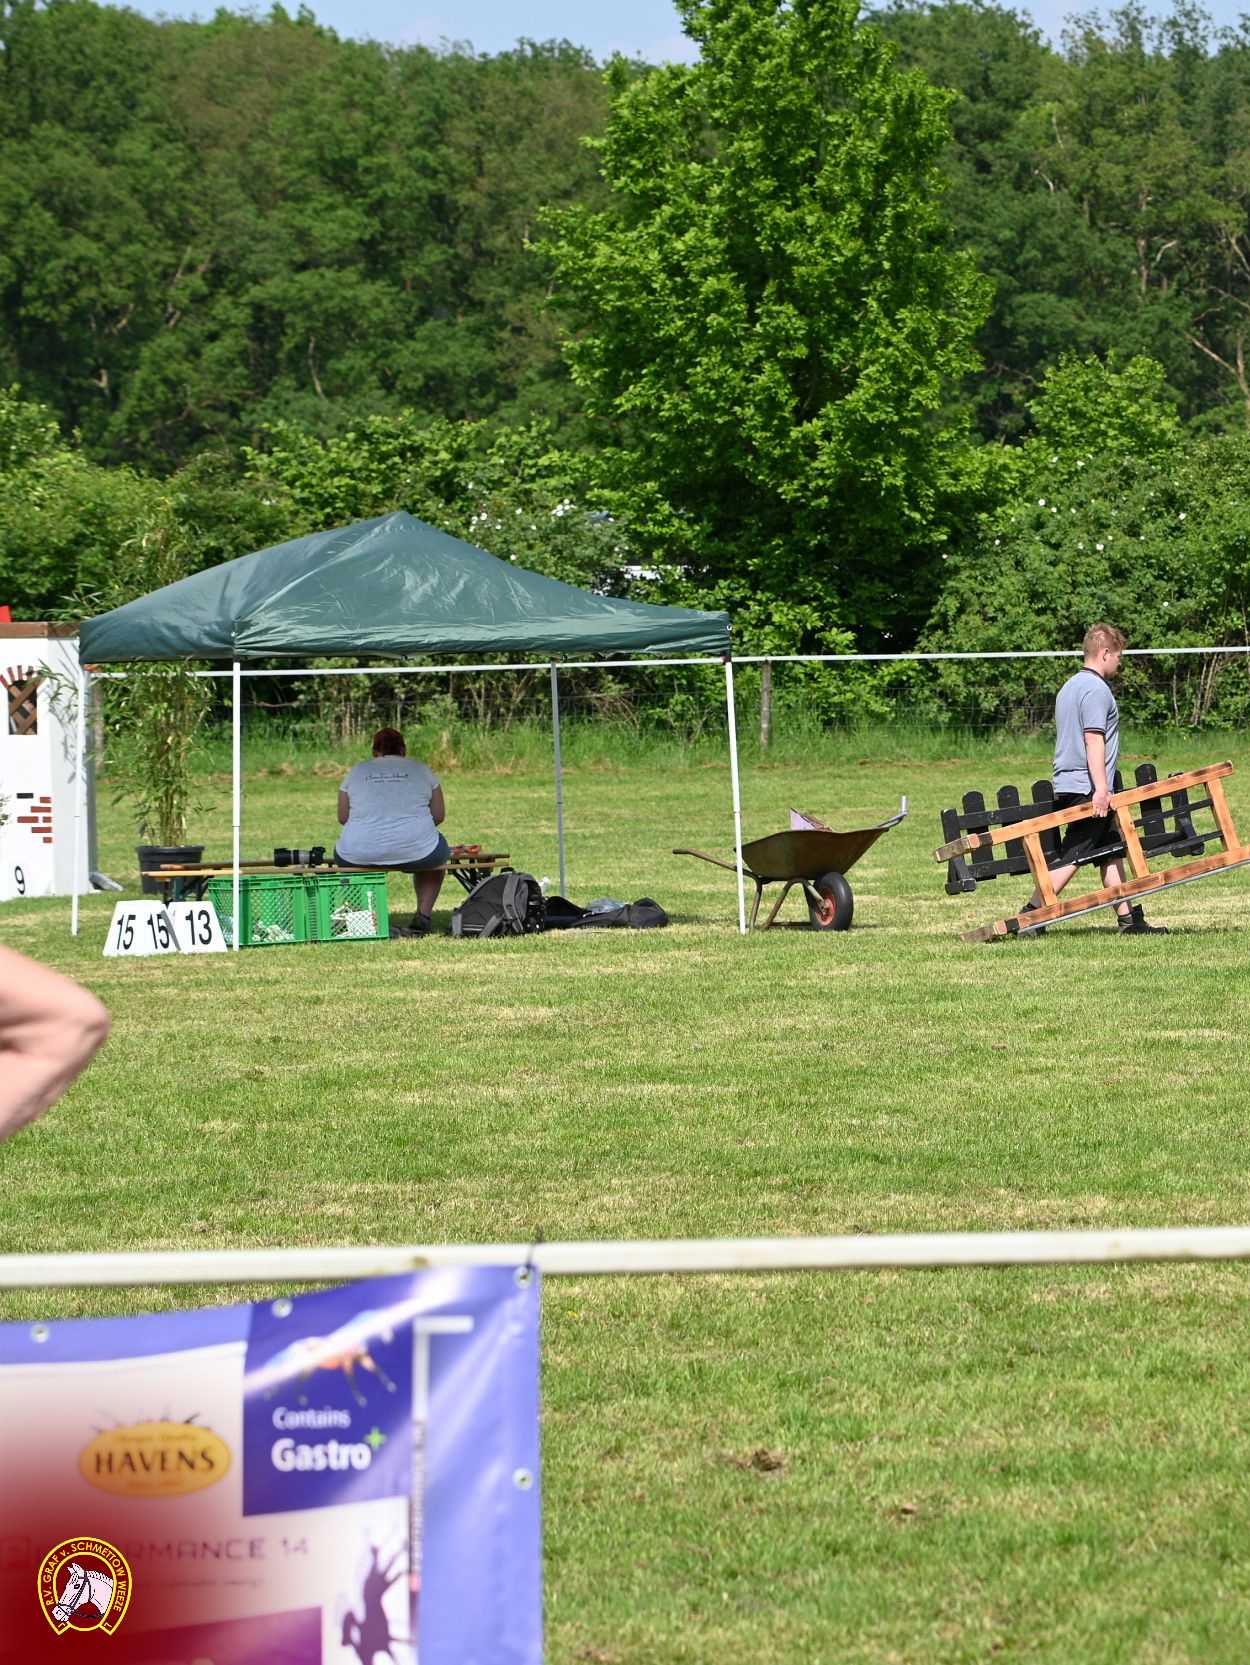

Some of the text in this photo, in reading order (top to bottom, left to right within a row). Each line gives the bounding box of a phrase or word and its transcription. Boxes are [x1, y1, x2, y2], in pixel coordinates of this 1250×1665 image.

[14, 865, 26, 896] 9
[116, 914, 136, 950] 15
[147, 913, 170, 950] 15
[185, 909, 212, 946] 13
[272, 1405, 352, 1430] Contains
[94, 1447, 216, 1475] HAVENS
